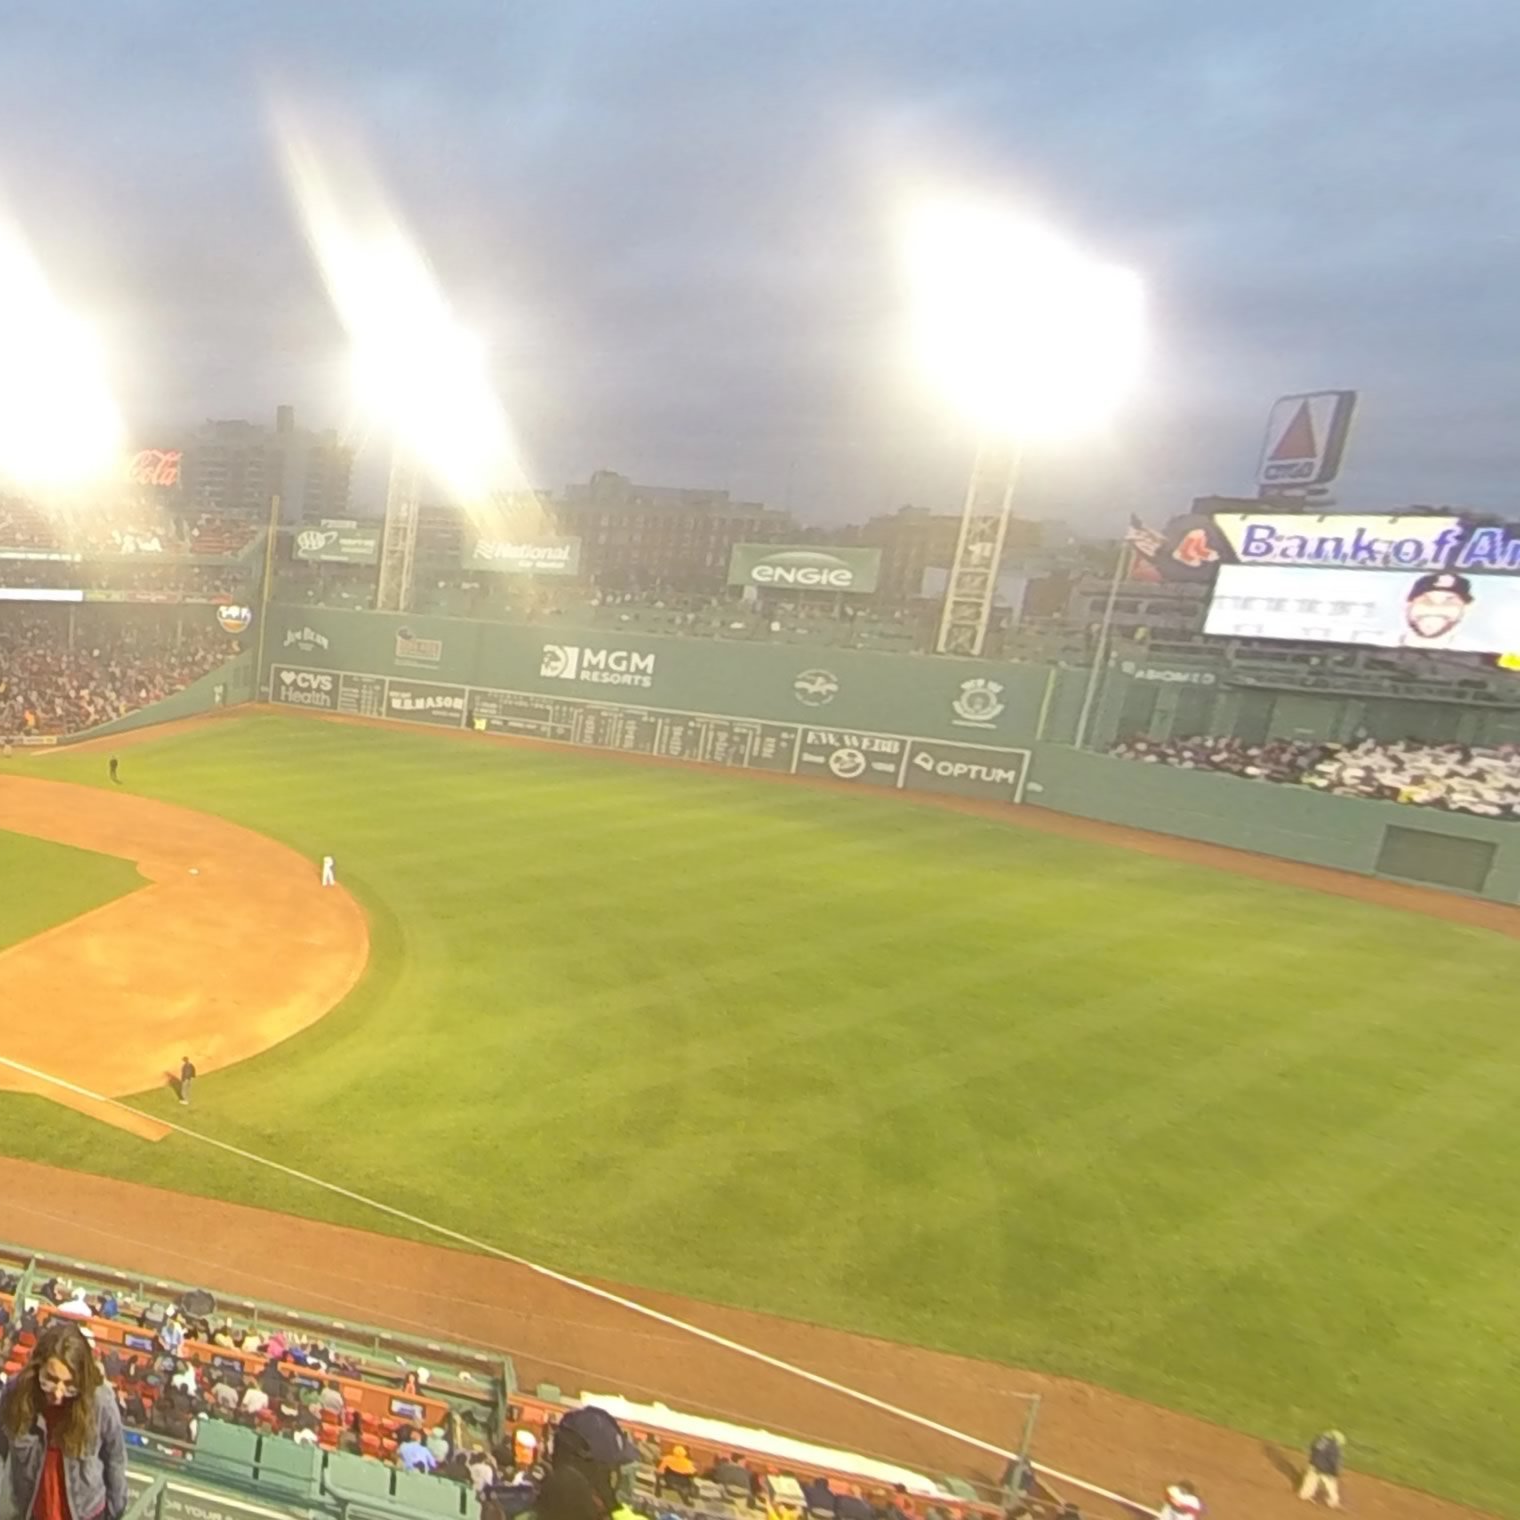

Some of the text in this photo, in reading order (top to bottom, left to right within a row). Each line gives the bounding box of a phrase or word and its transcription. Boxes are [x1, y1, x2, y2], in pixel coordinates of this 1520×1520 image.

[1241, 524, 1376, 563] Bank
[1392, 528, 1465, 569] of
[582, 648, 656, 675] MGM
[297, 672, 332, 691] CVS
[580, 670, 652, 687] RESORTS
[280, 686, 331, 706] Health
[843, 735, 900, 754] WEBB
[936, 761, 1016, 784] OPTUM
